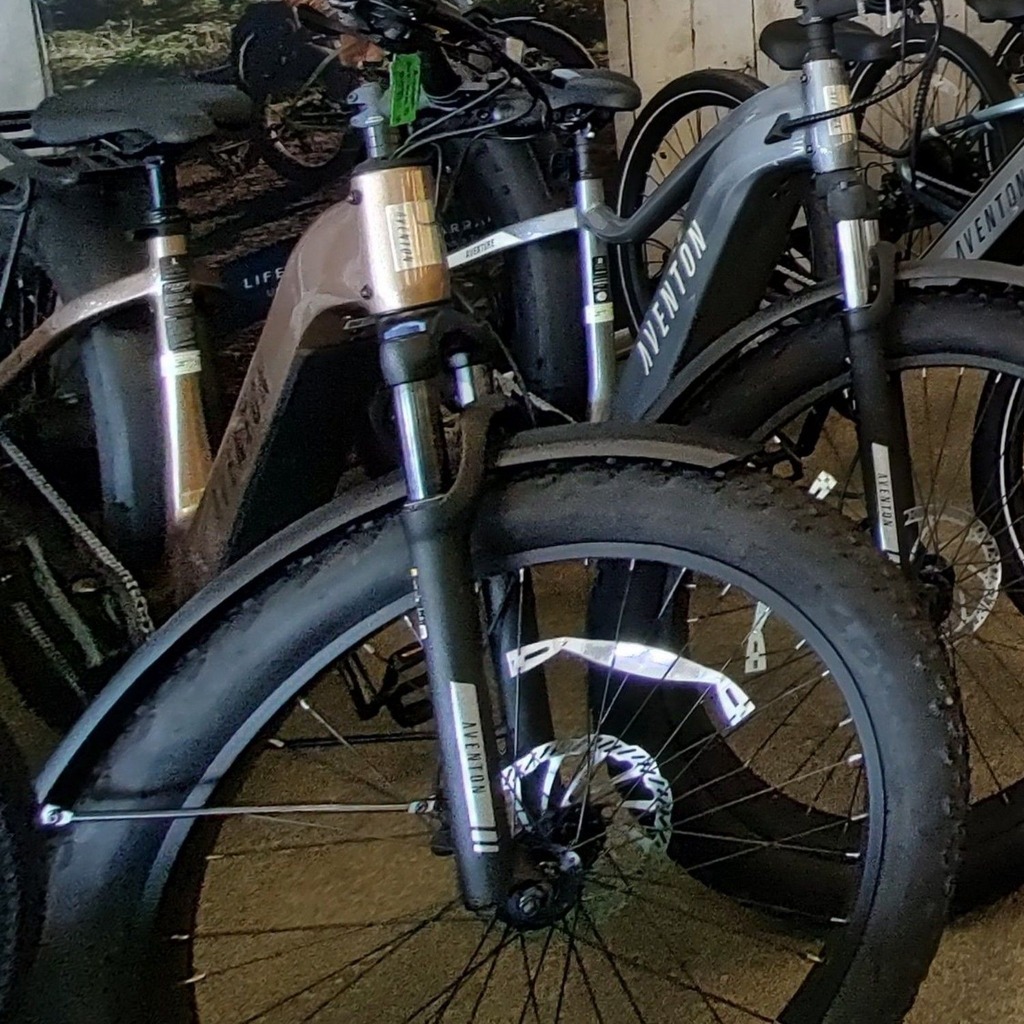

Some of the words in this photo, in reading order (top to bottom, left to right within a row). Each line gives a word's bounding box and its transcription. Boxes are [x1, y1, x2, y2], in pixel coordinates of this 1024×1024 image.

[637, 219, 707, 376] AVENTON
[877, 472, 895, 528] AVENTON
[462, 721, 487, 794] AVENTON
